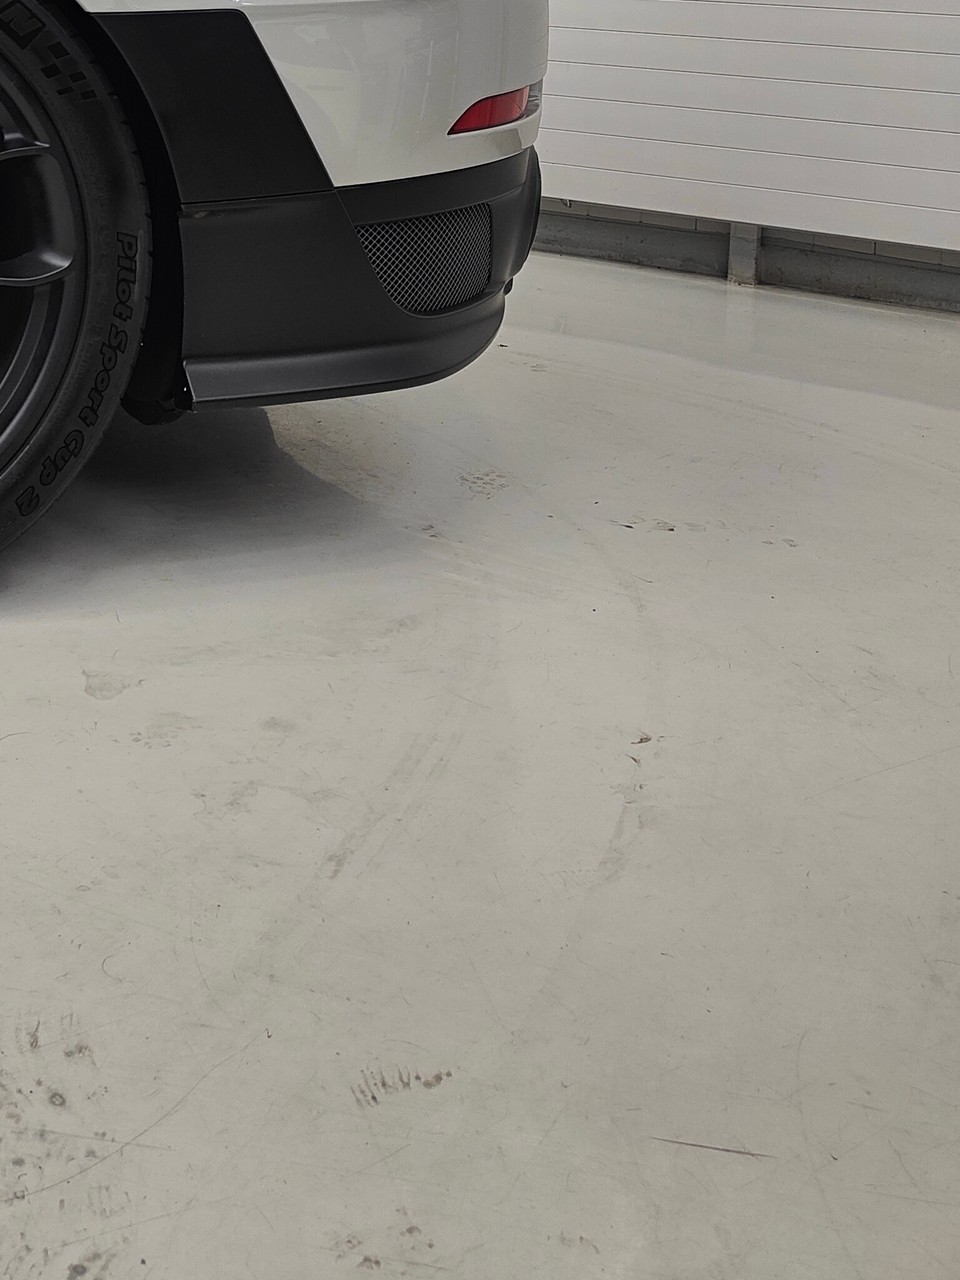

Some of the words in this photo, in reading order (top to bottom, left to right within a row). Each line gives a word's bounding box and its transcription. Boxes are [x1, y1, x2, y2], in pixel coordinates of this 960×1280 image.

[113, 231, 138, 321] Pilot
[79, 324, 129, 428] Sport
[39, 429, 85, 486] Cup
[16, 488, 40, 517] 2
